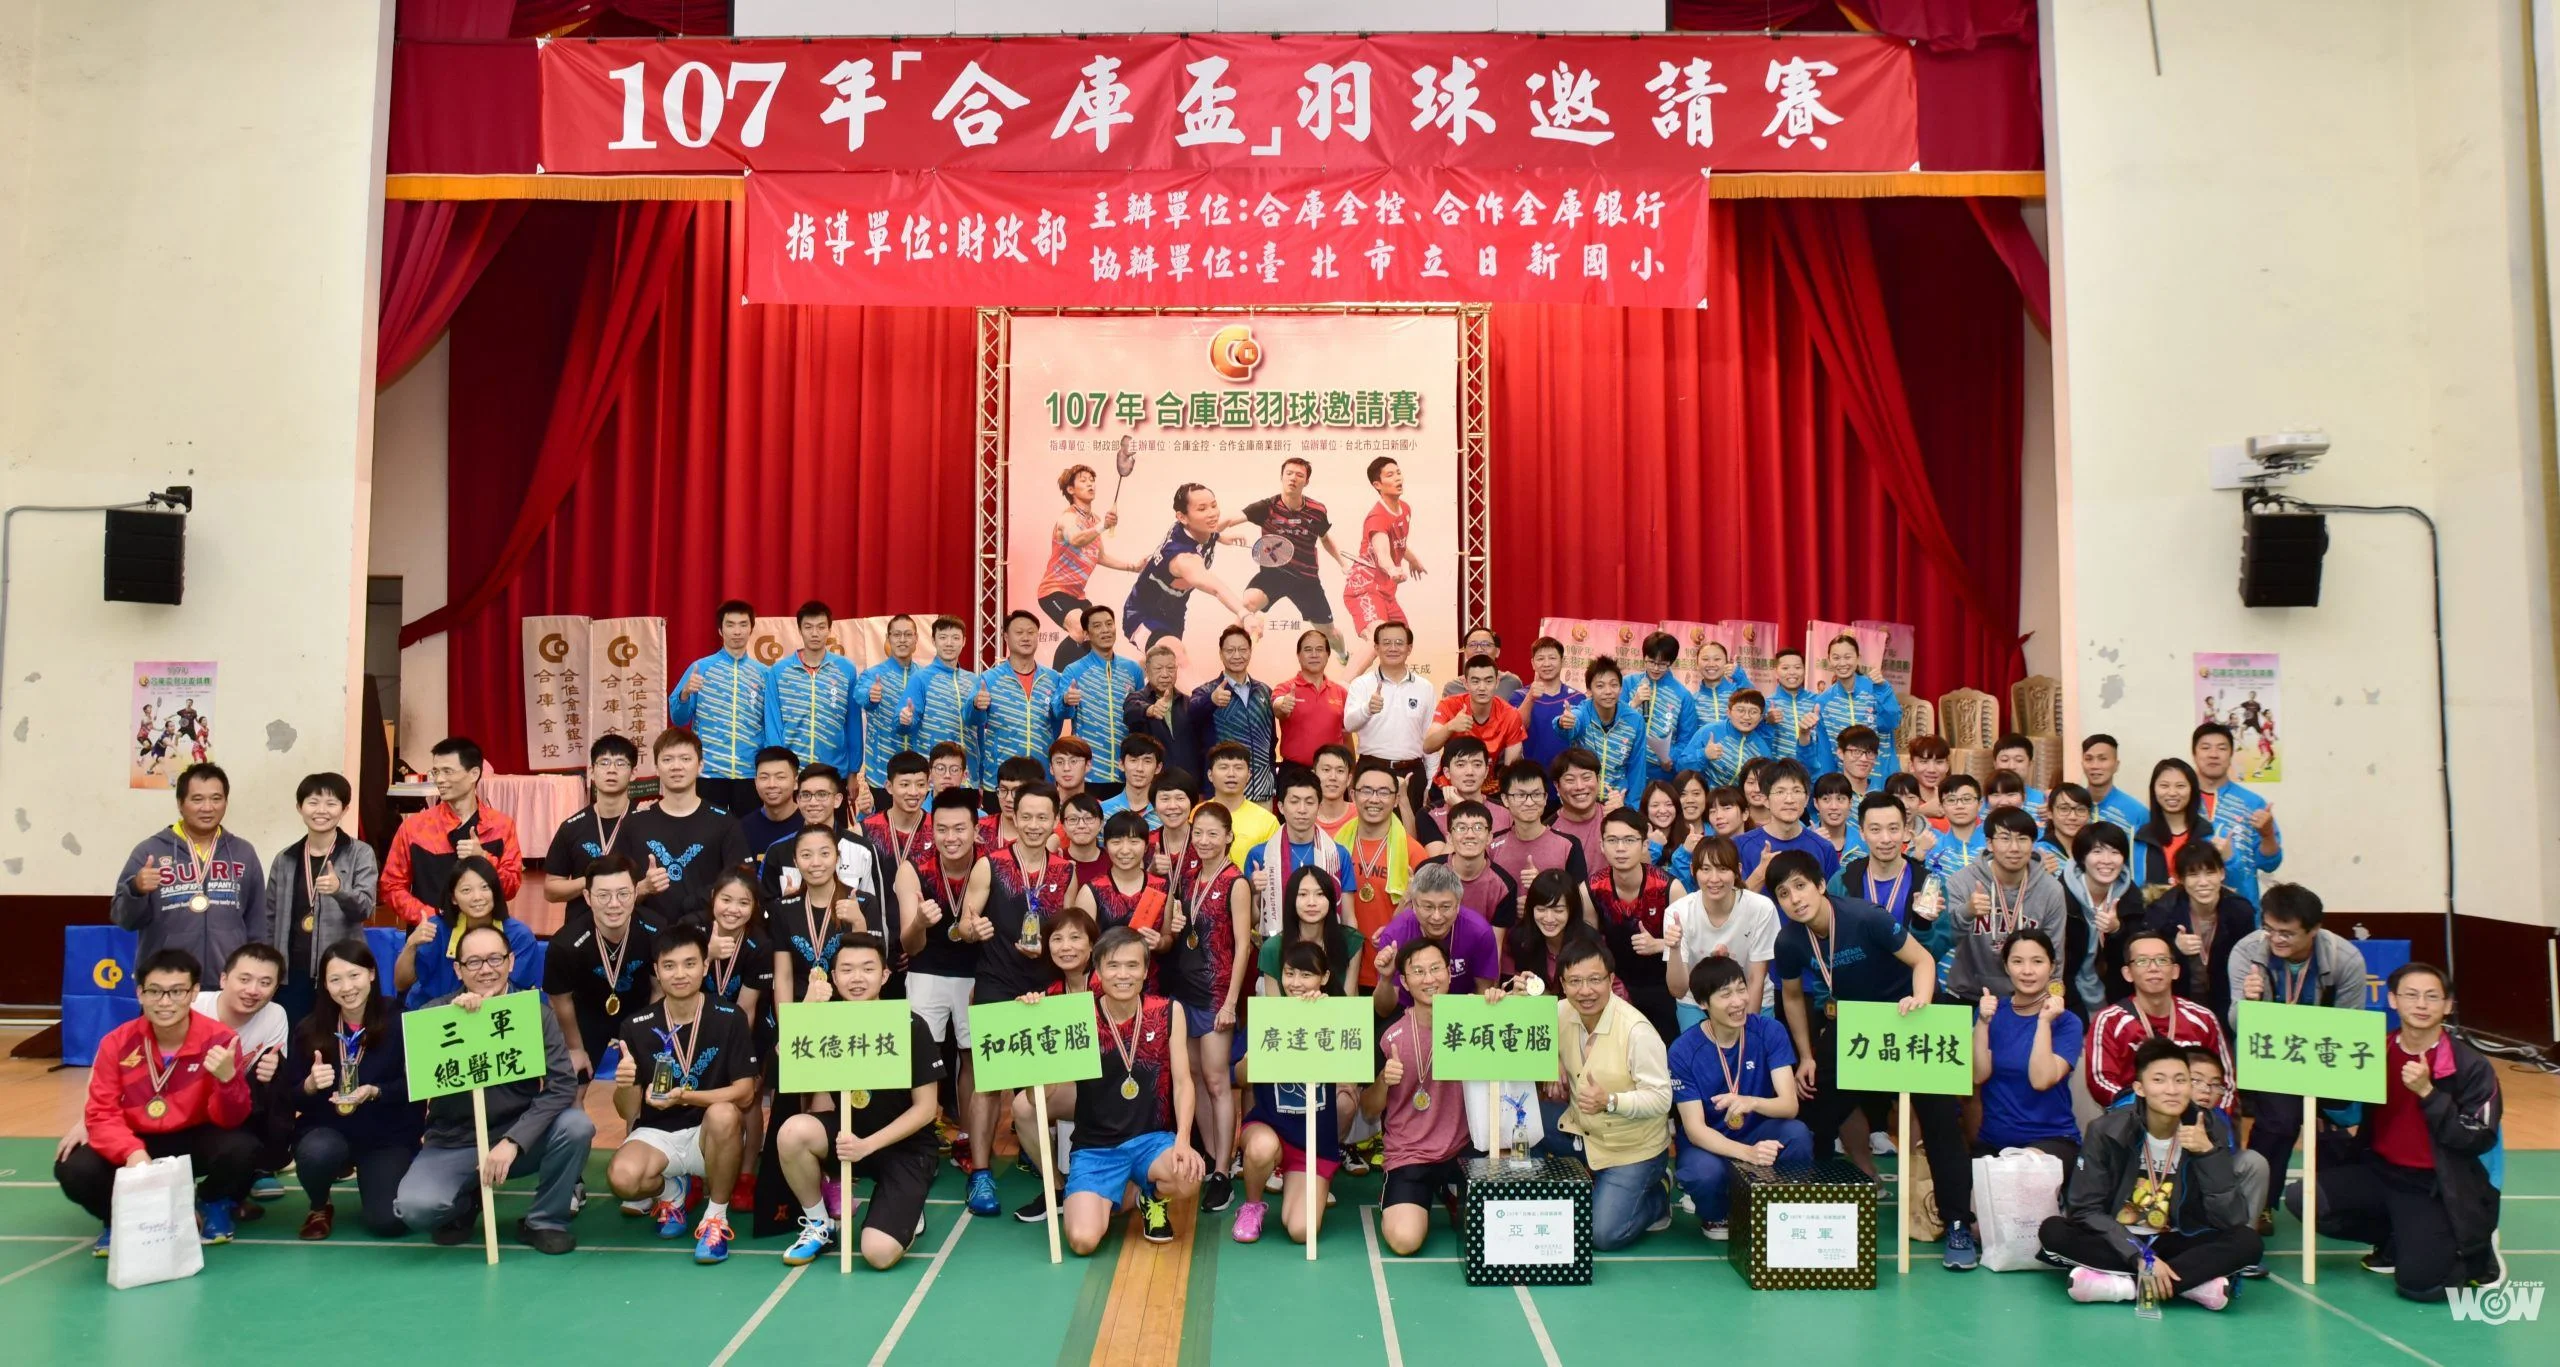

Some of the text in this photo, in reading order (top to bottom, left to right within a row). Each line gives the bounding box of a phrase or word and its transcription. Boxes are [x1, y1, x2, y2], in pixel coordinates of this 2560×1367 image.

[1155, 390, 1418, 426] 合庫盃羽球邀請賽
[1268, 620, 1300, 631] 王子維
[1405, 663, 1431, 675] 天成
[1828, 946, 1863, 960] OUNTAIN
[791, 1033, 900, 1059] 牧德科技
[979, 1020, 1091, 1062] 和碩電腦
[1260, 1026, 1363, 1053] 廣達電腦
[1441, 1022, 1552, 1053] 華碩電腦
[1846, 1032, 1966, 1066] 力晶科技
[2247, 1032, 2376, 1070] 旺宏電子
[434, 1047, 526, 1090] 總醫院
